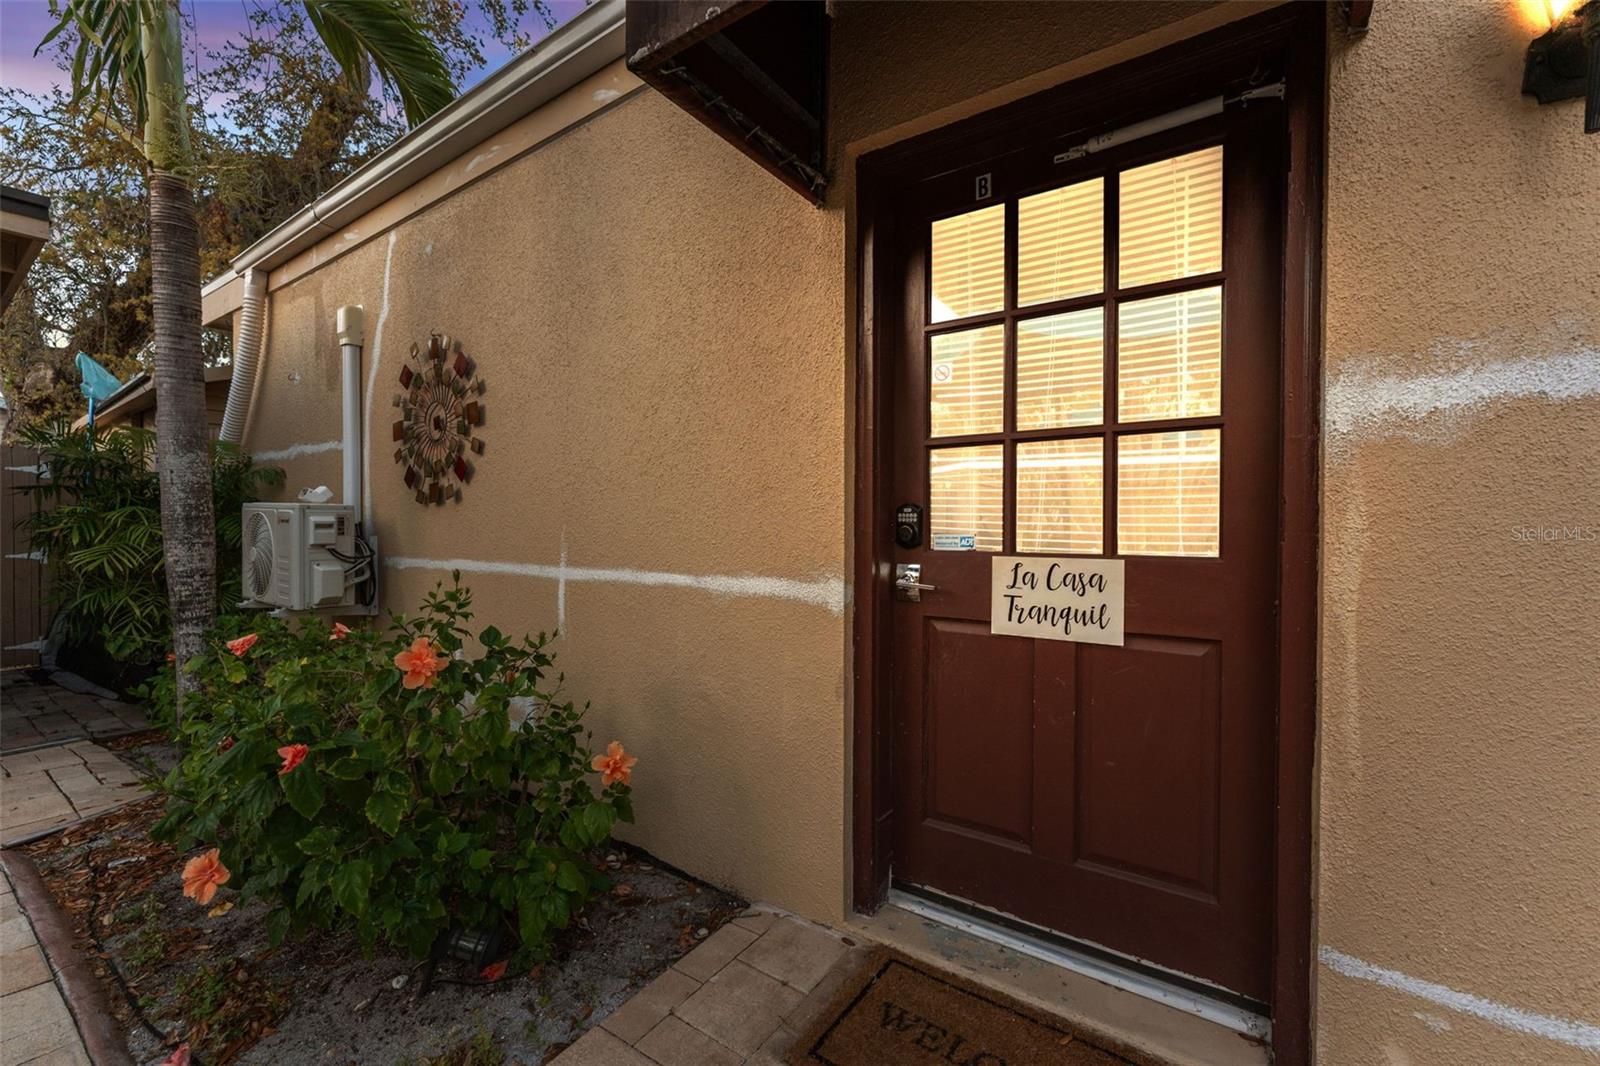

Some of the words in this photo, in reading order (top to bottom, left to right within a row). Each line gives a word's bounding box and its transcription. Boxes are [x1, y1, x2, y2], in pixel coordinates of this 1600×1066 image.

[978, 177, 988, 198] B
[1006, 562, 1038, 590] La
[1046, 563, 1107, 597] Casa
[1003, 594, 1111, 635] Tranquil
